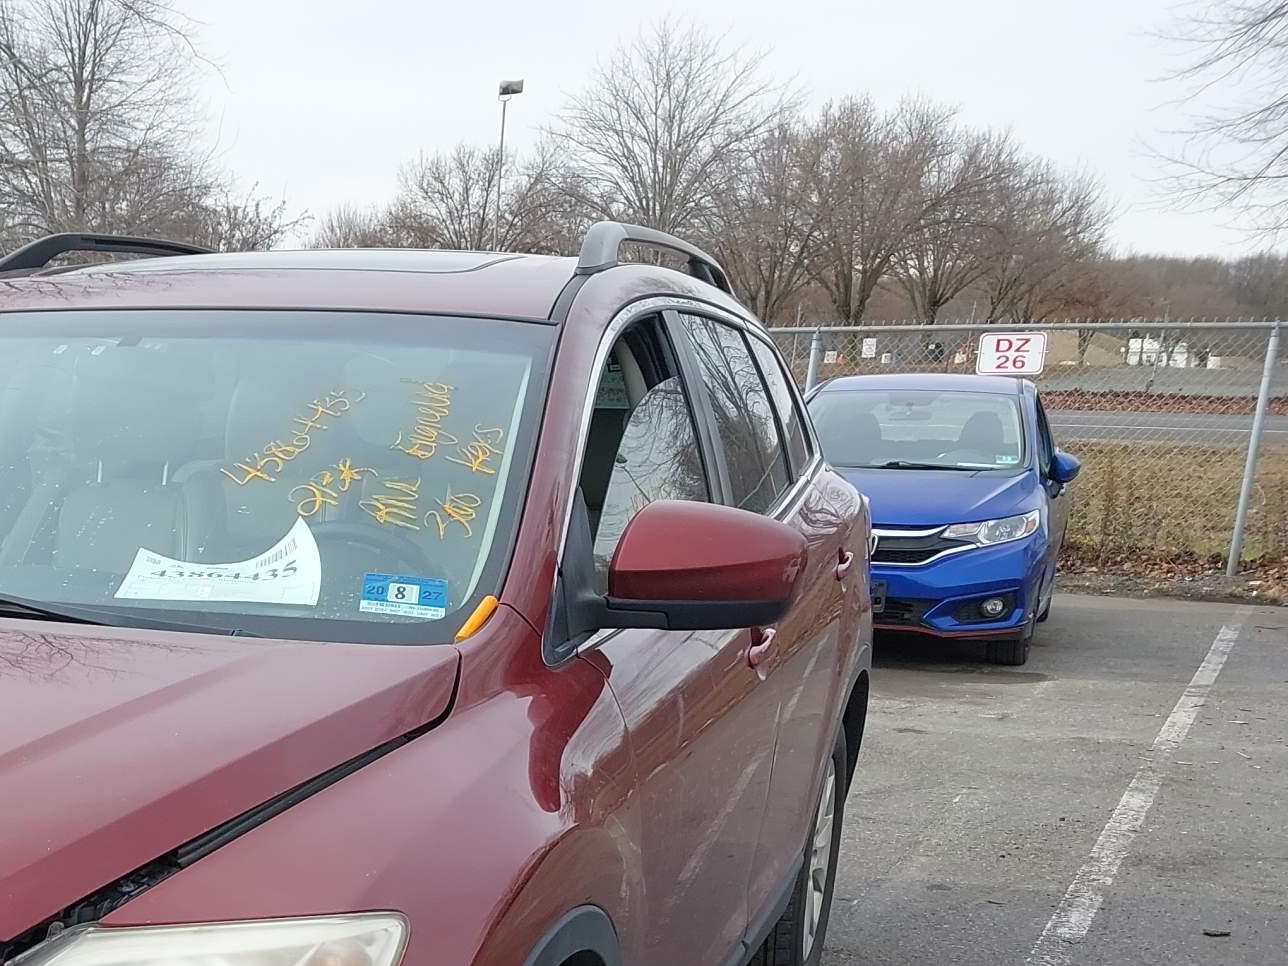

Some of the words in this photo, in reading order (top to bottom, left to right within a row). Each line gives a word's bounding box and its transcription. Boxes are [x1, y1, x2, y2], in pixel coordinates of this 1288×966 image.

[995, 338, 1032, 353] DZ
[995, 355, 1026, 369] 26
[150, 559, 298, 582] 43864435
[366, 585, 385, 596] 20
[394, 585, 407, 600] 8
[422, 590, 442, 600] 27
